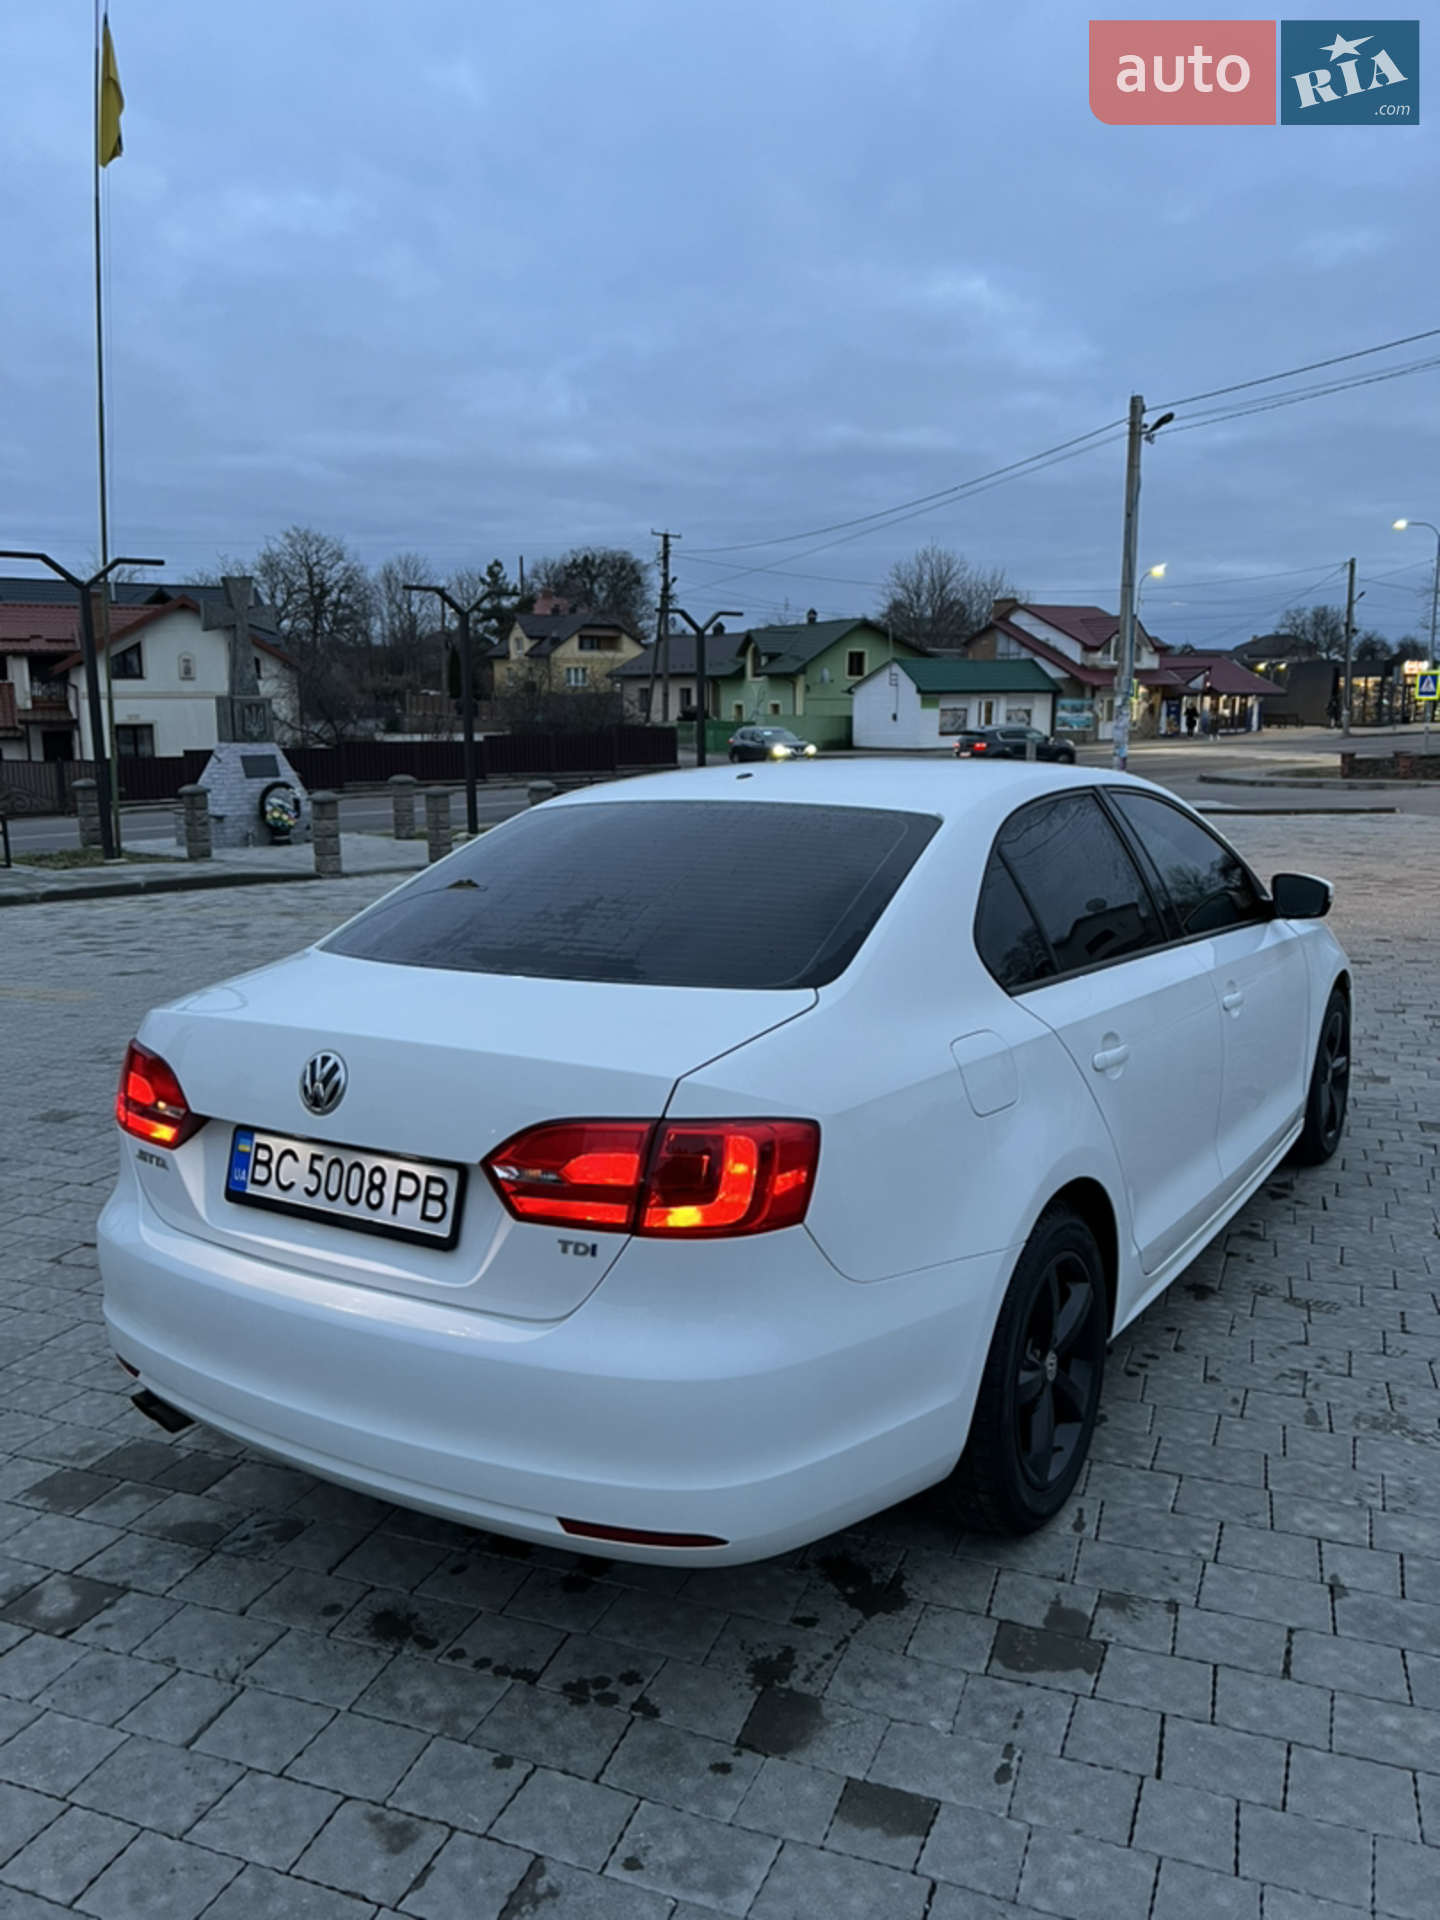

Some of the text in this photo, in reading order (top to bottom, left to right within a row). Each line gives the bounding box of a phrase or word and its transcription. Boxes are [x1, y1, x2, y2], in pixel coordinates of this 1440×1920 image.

[233, 1167, 247, 1181] UA
[250, 1142, 449, 1223] BC 5008 PB
[557, 1239, 598, 1258] TDI
